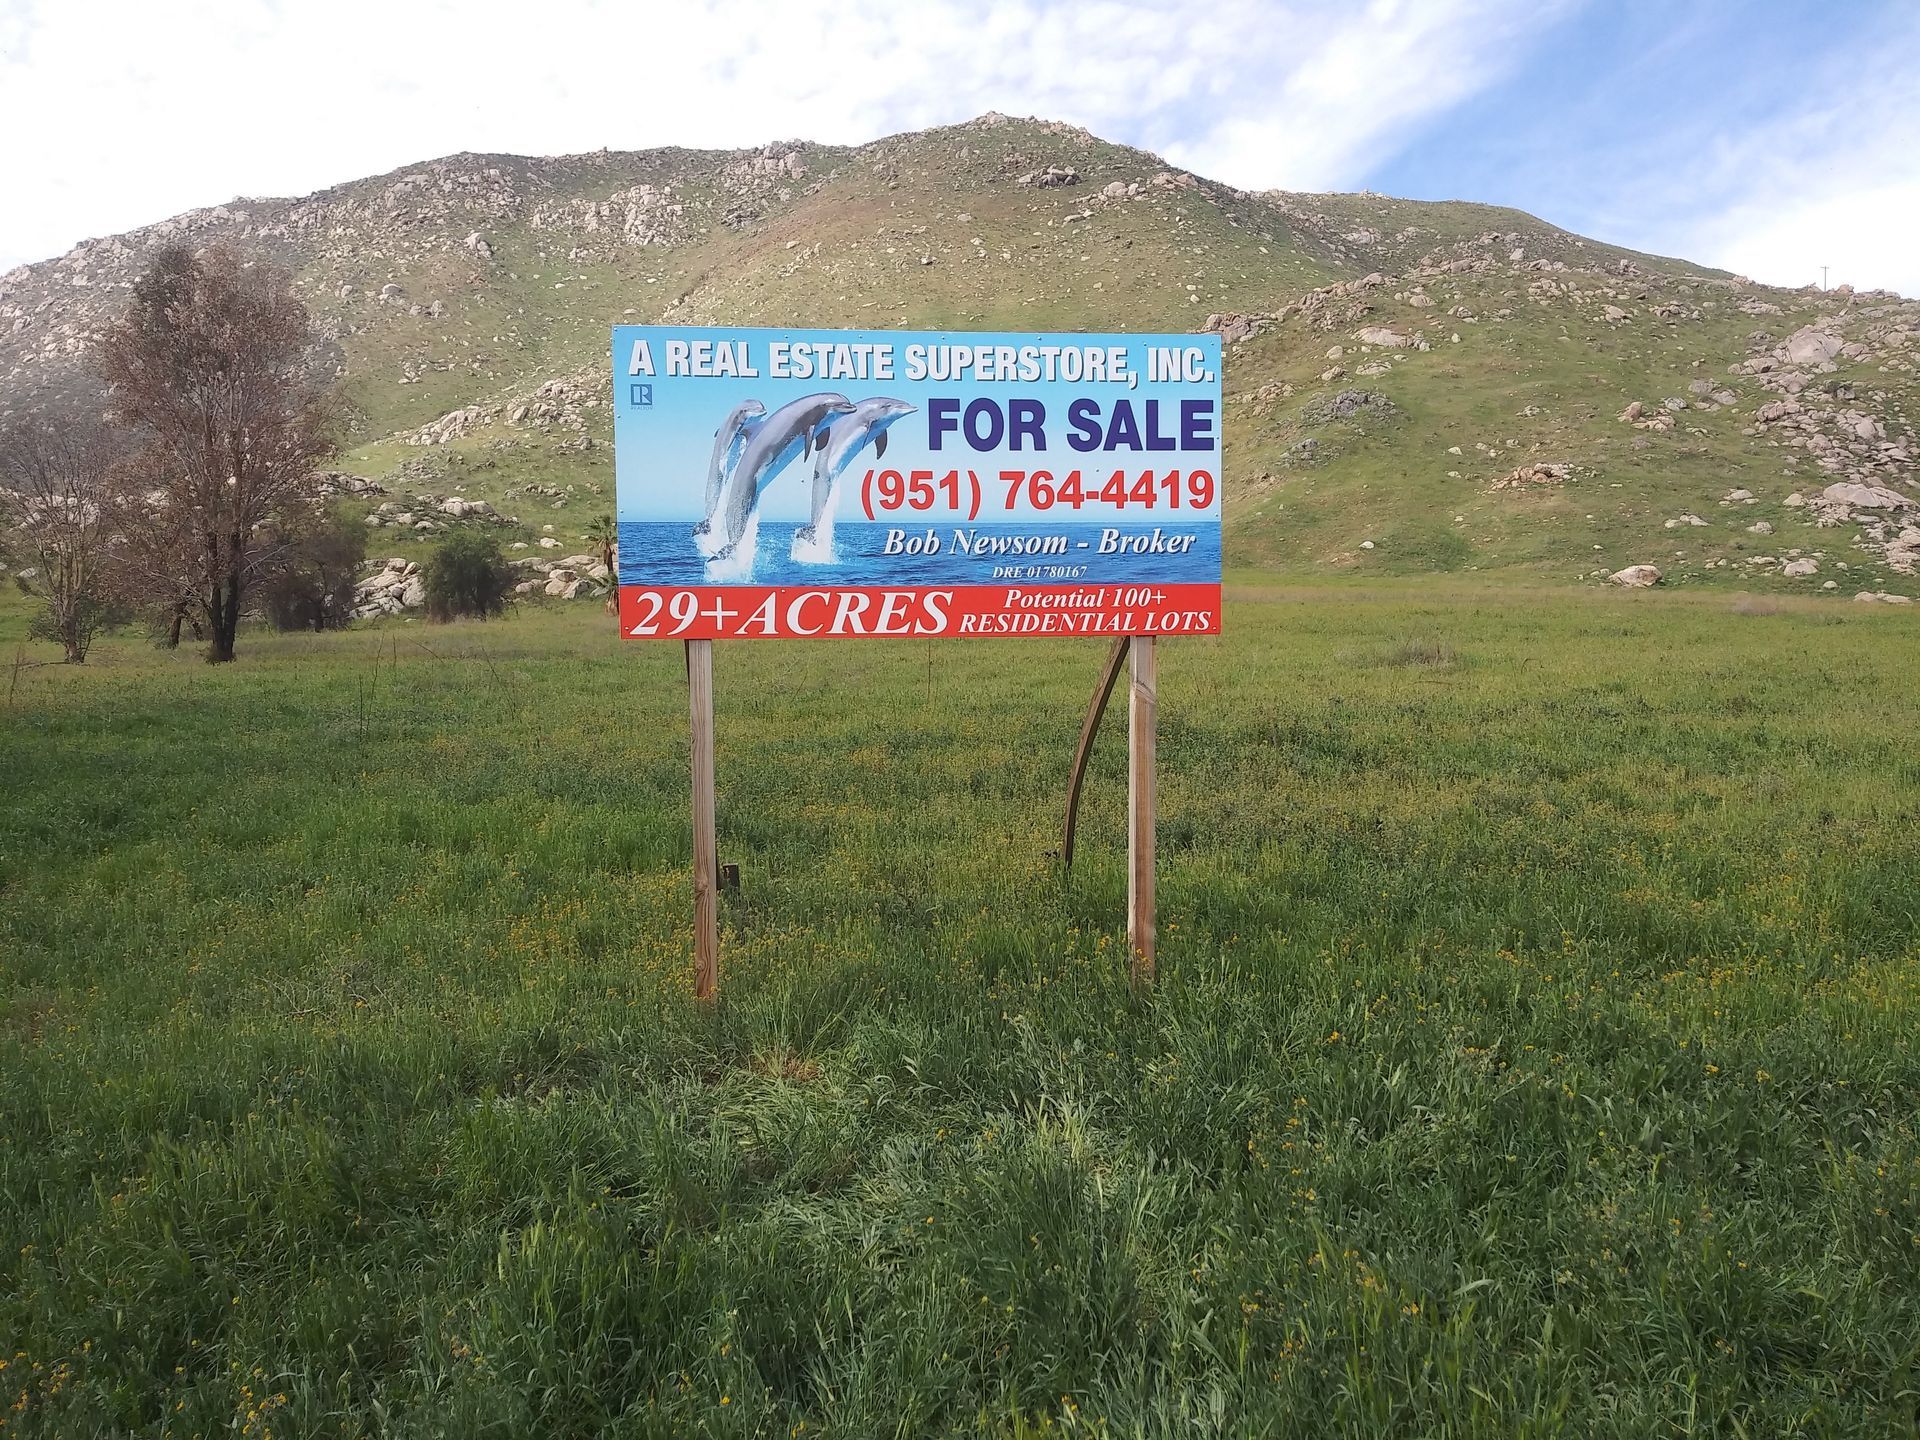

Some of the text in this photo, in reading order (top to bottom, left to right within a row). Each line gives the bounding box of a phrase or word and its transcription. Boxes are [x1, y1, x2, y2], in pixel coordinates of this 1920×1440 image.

[628, 339, 1215, 389] A REAL ESTATE SUPERSTORE, INC.
[928, 397, 1215, 452] FOR SALE
[861, 469, 1215, 521] (951) 764-4419
[883, 529, 942, 556] Bob
[949, 529, 1068, 555] Newsom
[1096, 528, 1197, 555] Broker
[992, 566, 1088, 579] DRE 01780167
[1003, 588, 1167, 608] Potential 100+
[957, 611, 1213, 634] RESIDENTIAL LOTS
